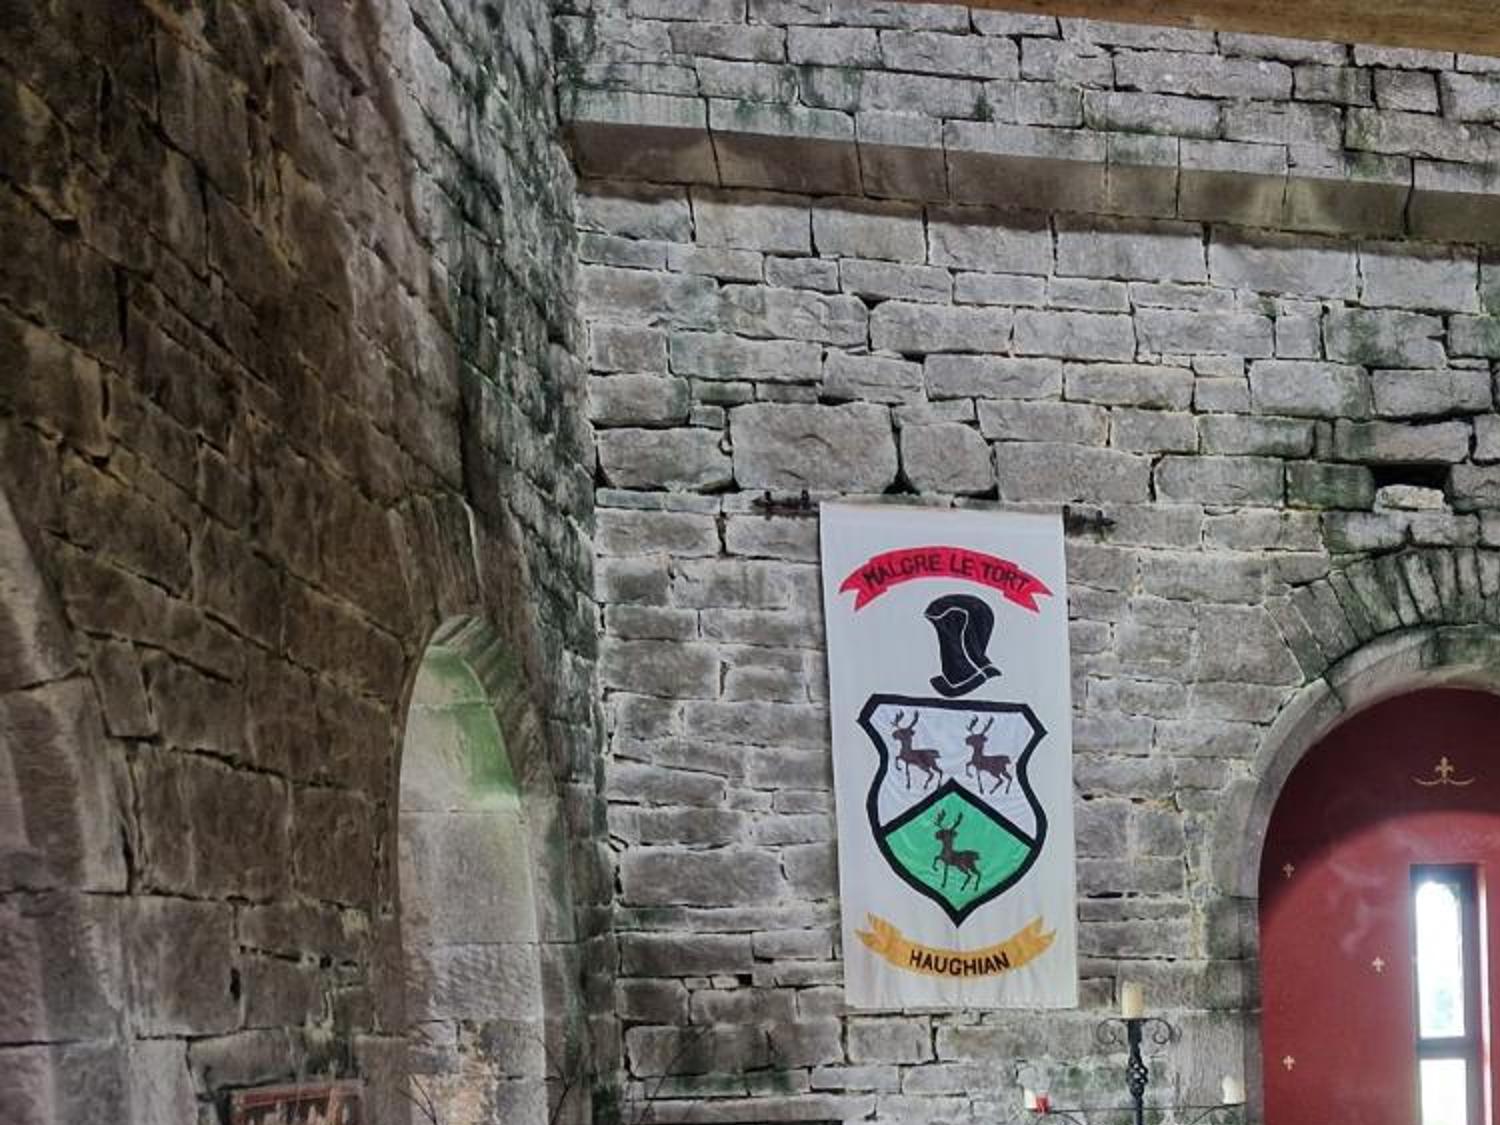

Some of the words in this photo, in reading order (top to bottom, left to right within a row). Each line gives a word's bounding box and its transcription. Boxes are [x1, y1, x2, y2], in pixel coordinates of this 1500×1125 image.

[863, 554, 941, 590] MALGRE
[949, 553, 976, 577] LE
[983, 563, 1030, 593] TORT
[909, 949, 1010, 977] HAUGHIAN
